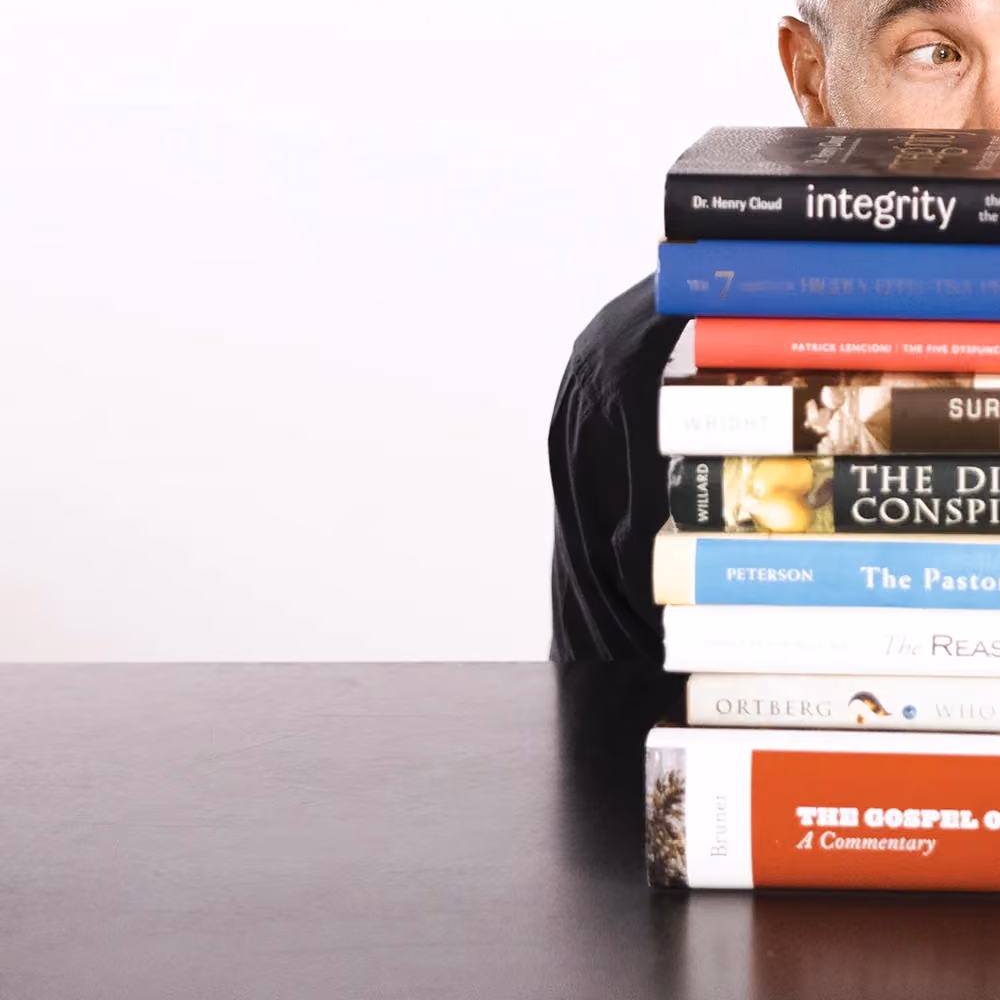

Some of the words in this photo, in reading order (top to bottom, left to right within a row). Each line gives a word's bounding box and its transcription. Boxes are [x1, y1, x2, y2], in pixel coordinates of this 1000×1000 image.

[691, 195, 709, 209] Dr.
[712, 196, 746, 212] Henry
[750, 196, 782, 210] Cloud
[806, 184, 956, 230] integrity
[979, 211, 998, 222] the
[714, 270, 735, 300] 7
[791, 342, 836, 353] PATRICK
[839, 343, 892, 353] LENCIONI
[903, 343, 923, 353] THE
[926, 344, 948, 354] FIVE
[850, 464, 933, 493] THE
[695, 463, 709, 522] WILLARD
[726, 567, 814, 582] PETERSON
[860, 567, 912, 589] The
[715, 698, 833, 717] ORTBERG
[934, 702, 997, 720] WHO
[797, 806, 858, 827] THE
[864, 807, 978, 830] GOSPEL
[797, 831, 813, 849] A
[819, 831, 936, 856] Commentary
